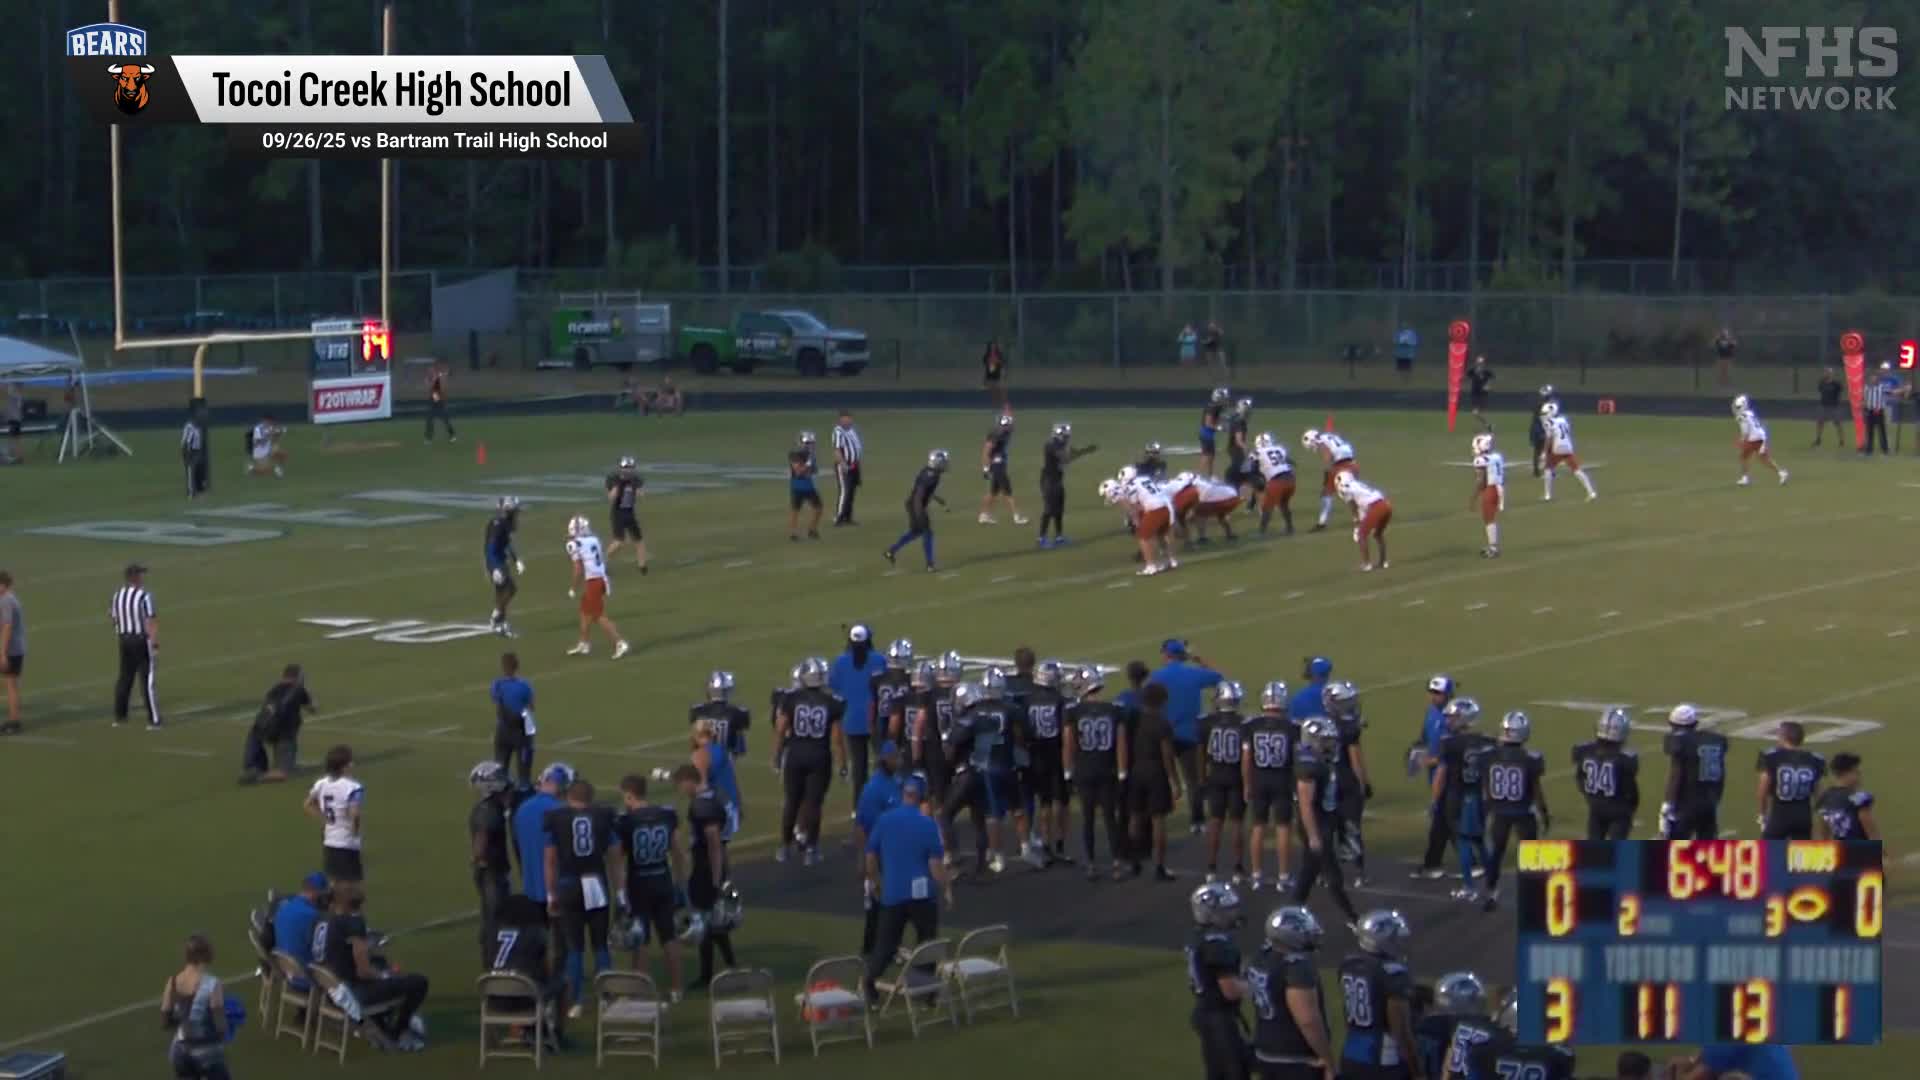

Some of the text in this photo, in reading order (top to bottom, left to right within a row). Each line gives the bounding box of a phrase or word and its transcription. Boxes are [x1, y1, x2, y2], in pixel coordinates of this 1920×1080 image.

[362, 320, 389, 360] 14
[1900, 344, 1915, 368] 3
[794, 704, 828, 738] 63
[1207, 728, 1240, 763] 40
[1253, 731, 1288, 768] 53
[1489, 764, 1524, 801] 88
[1582, 758, 1617, 797] 34
[571, 816, 594, 857] 8
[632, 824, 670, 865] 82
[495, 930, 518, 969] 7
